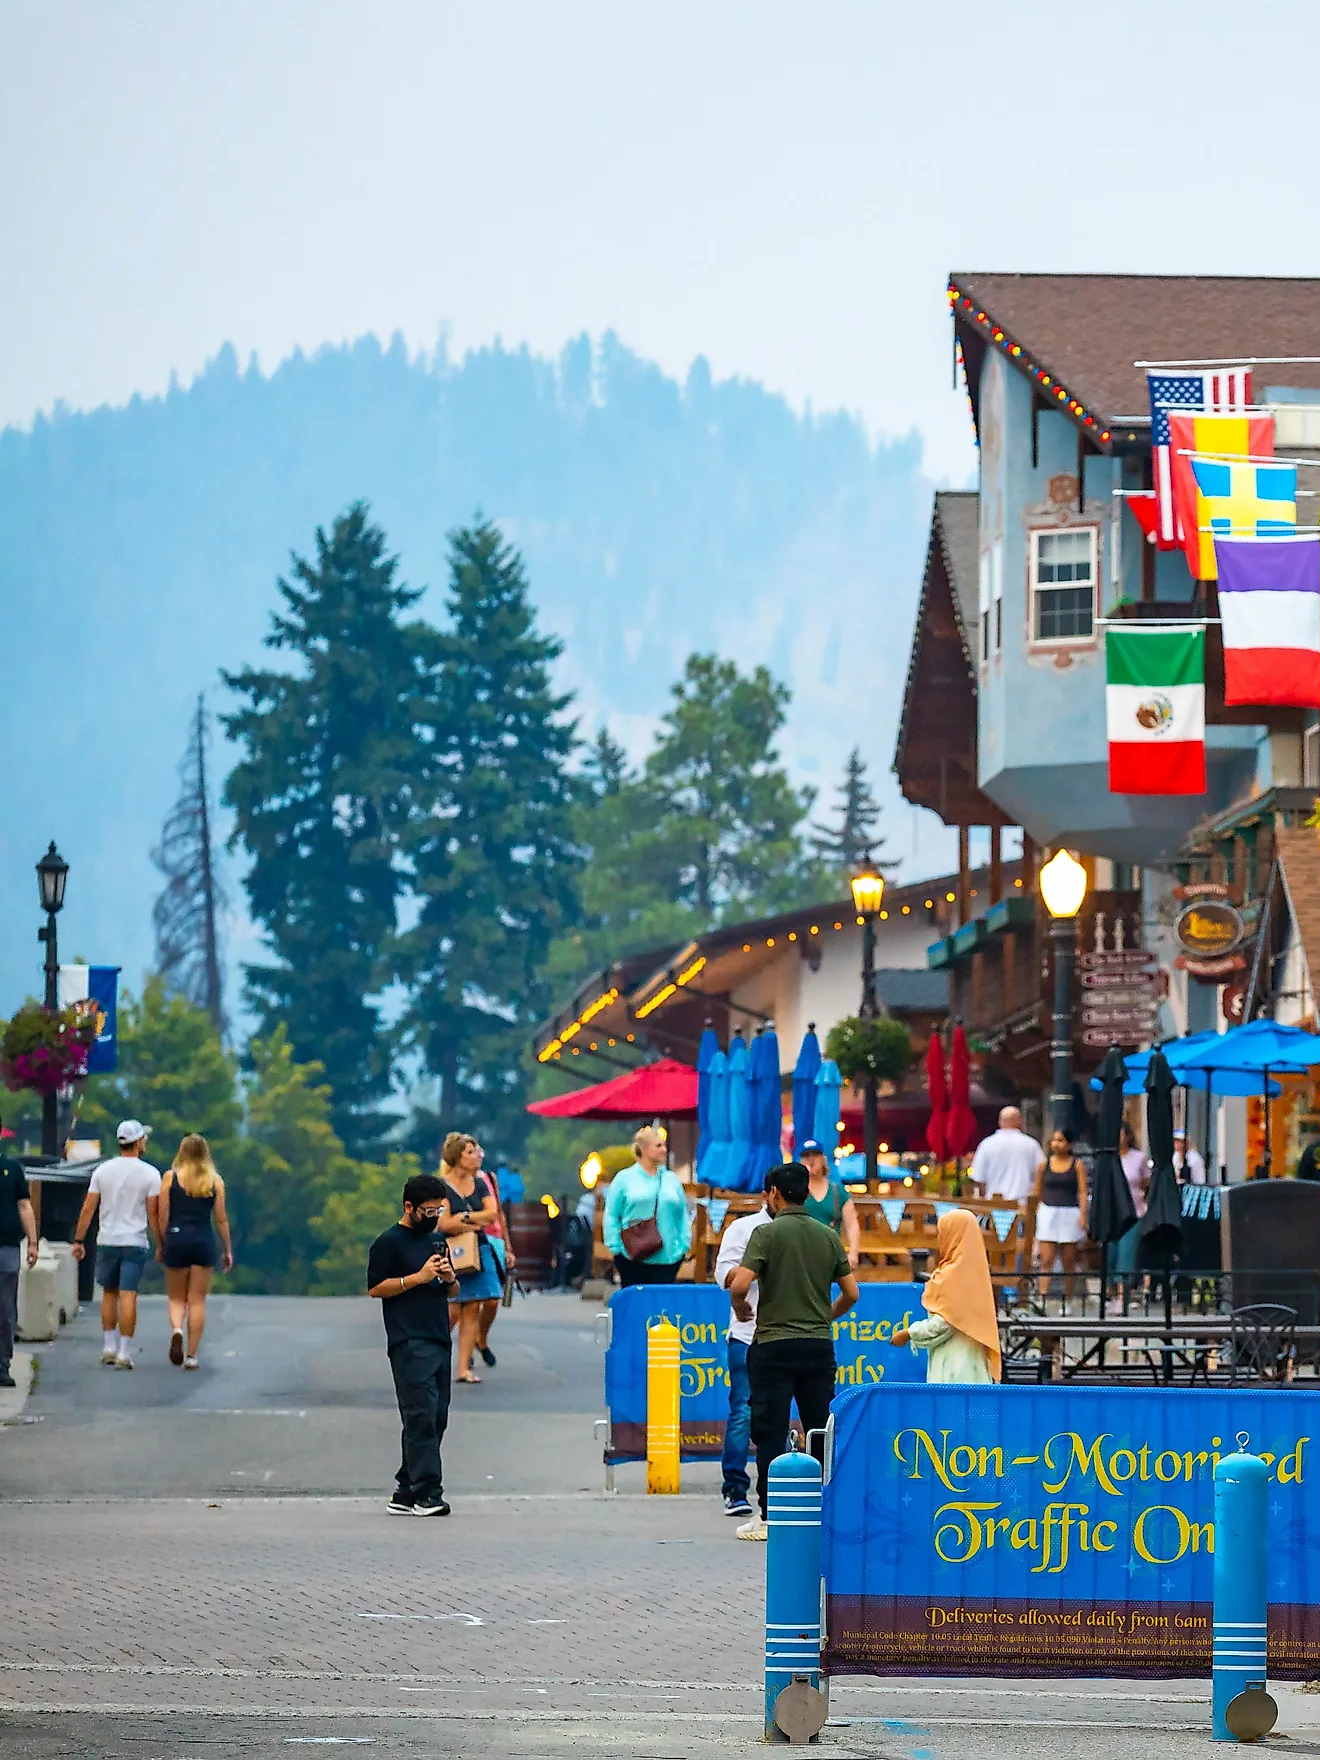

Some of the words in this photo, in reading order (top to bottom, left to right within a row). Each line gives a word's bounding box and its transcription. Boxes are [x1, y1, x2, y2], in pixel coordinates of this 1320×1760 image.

[835, 1355, 885, 1385] nly
[893, 1428, 1311, 1496] Non-Motoried
[933, 1501, 1118, 1573] Traffic
[1133, 1505, 1215, 1564] On
[924, 1607, 1014, 1628] Deliveries
[1018, 1608, 1083, 1626] allowed
[1086, 1611, 1126, 1634] daily
[1128, 1611, 1169, 1634] from
[1174, 1612, 1208, 1628] 6am
[899, 1631, 929, 1642] Chapter
[908, 1643, 935, 1651] vehicle
[946, 1644, 967, 1652] truck
[967, 1644, 990, 1652] which
[999, 1645, 1021, 1653] found
[1179, 1649, 1194, 1657] this
[1195, 1648, 1214, 1658] chap
